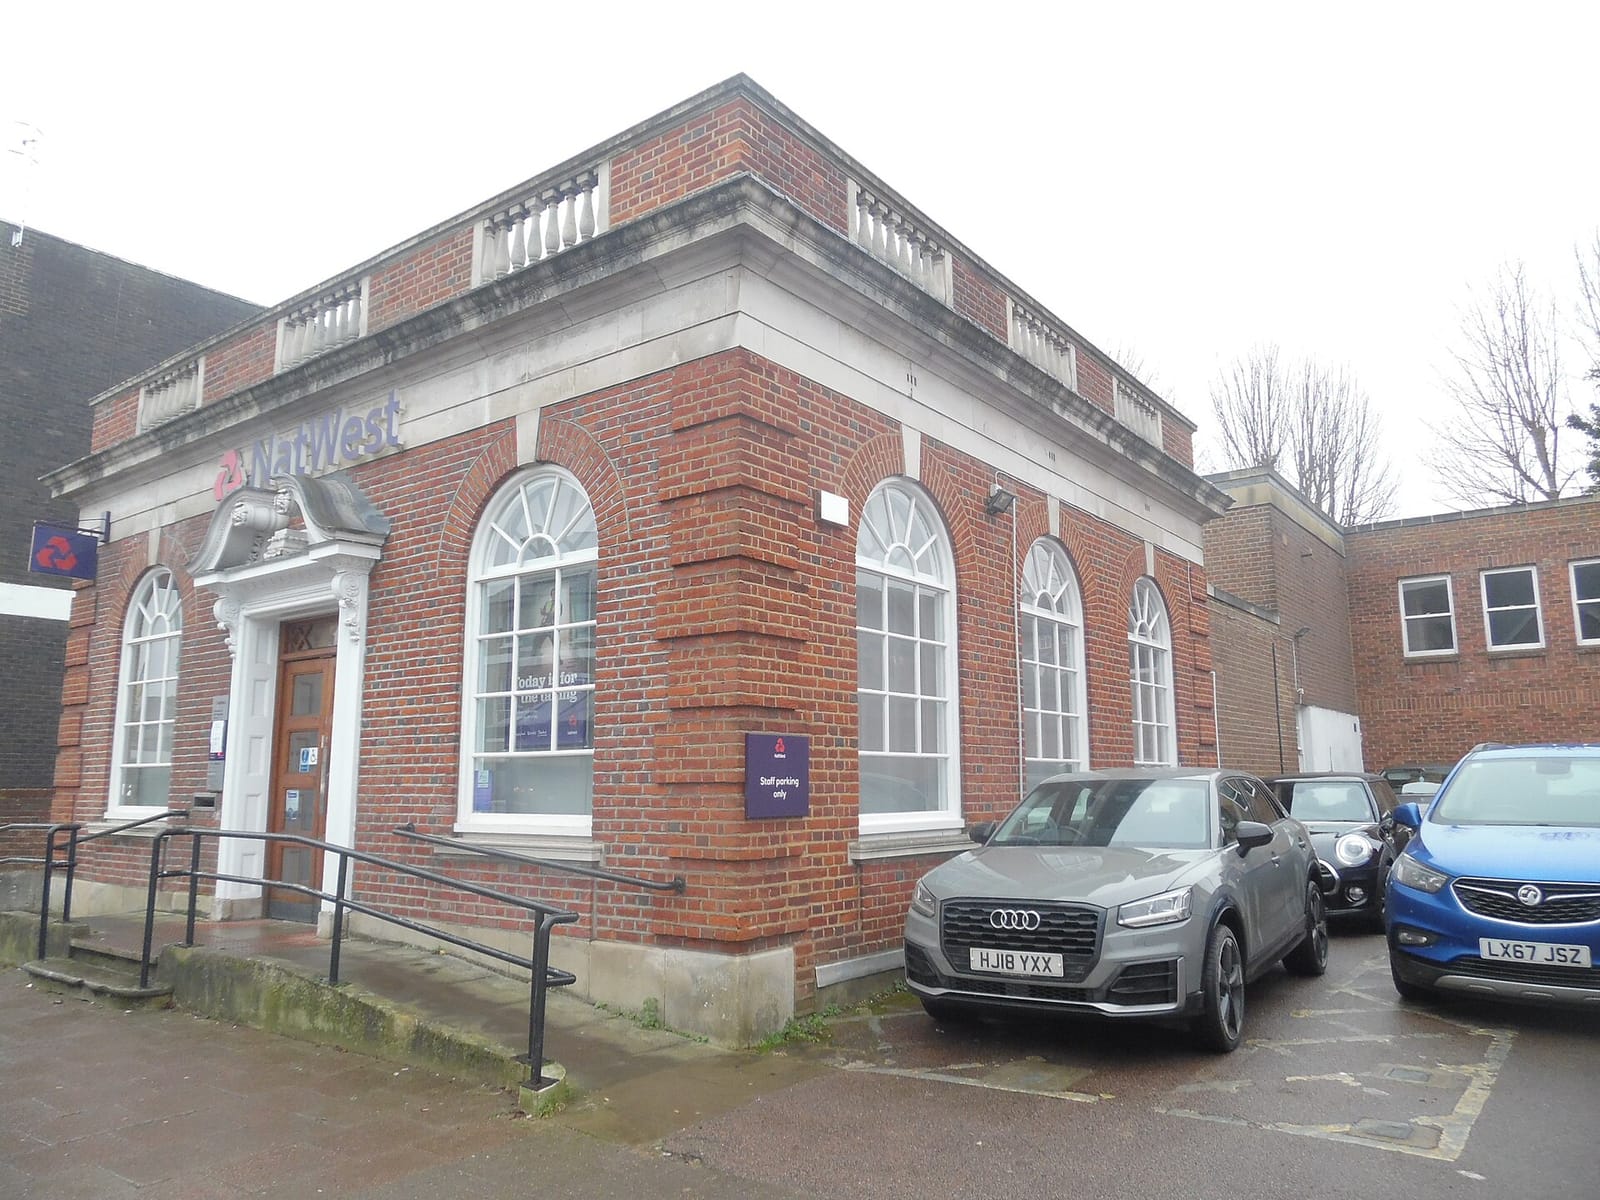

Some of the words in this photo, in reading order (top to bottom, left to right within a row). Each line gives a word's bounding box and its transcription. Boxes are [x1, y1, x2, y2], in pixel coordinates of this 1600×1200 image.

[251, 388, 400, 489] NatWest
[517, 674, 546, 689] oday
[560, 671, 577, 685] for
[540, 690, 577, 703] taing
[760, 776, 775, 786] Staff
[775, 776, 799, 788] parking
[773, 789, 787, 800] only
[1487, 941, 1536, 960] LX67
[1544, 946, 1582, 964] JSZ
[980, 951, 1015, 970] HJ18
[1019, 954, 1052, 973] YXX
